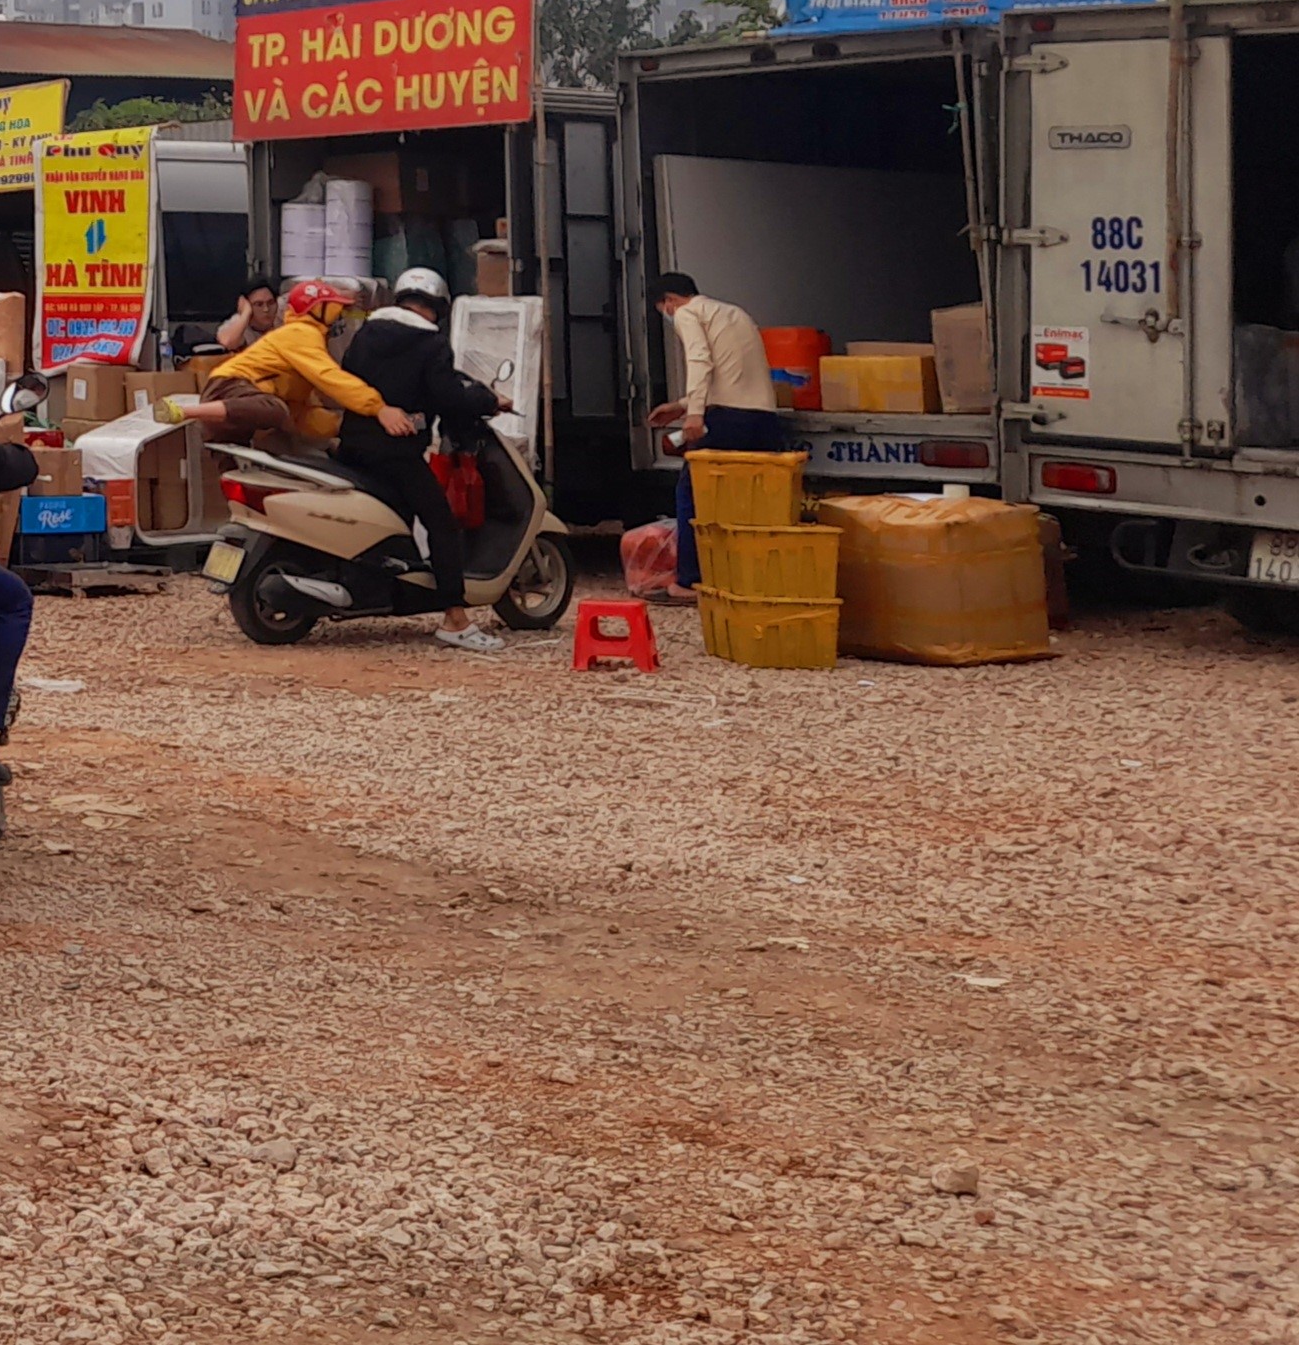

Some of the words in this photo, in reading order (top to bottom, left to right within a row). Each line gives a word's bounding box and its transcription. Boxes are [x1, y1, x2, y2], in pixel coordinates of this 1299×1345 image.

[249, 32, 289, 68] TP.
[301, 13, 361, 64] HẢI
[374, 6, 515, 56] DƯƠNG
[244, 78, 290, 122] VÀ
[302, 70, 383, 119] CÁC
[395, 58, 518, 116] HUYỆN
[1056, 132, 1124, 144] THACO
[64, 189, 125, 213] VINH
[1091, 216, 1144, 250] 88C
[46, 259, 78, 287] HÀ
[1080, 259, 1160, 294] 14031
